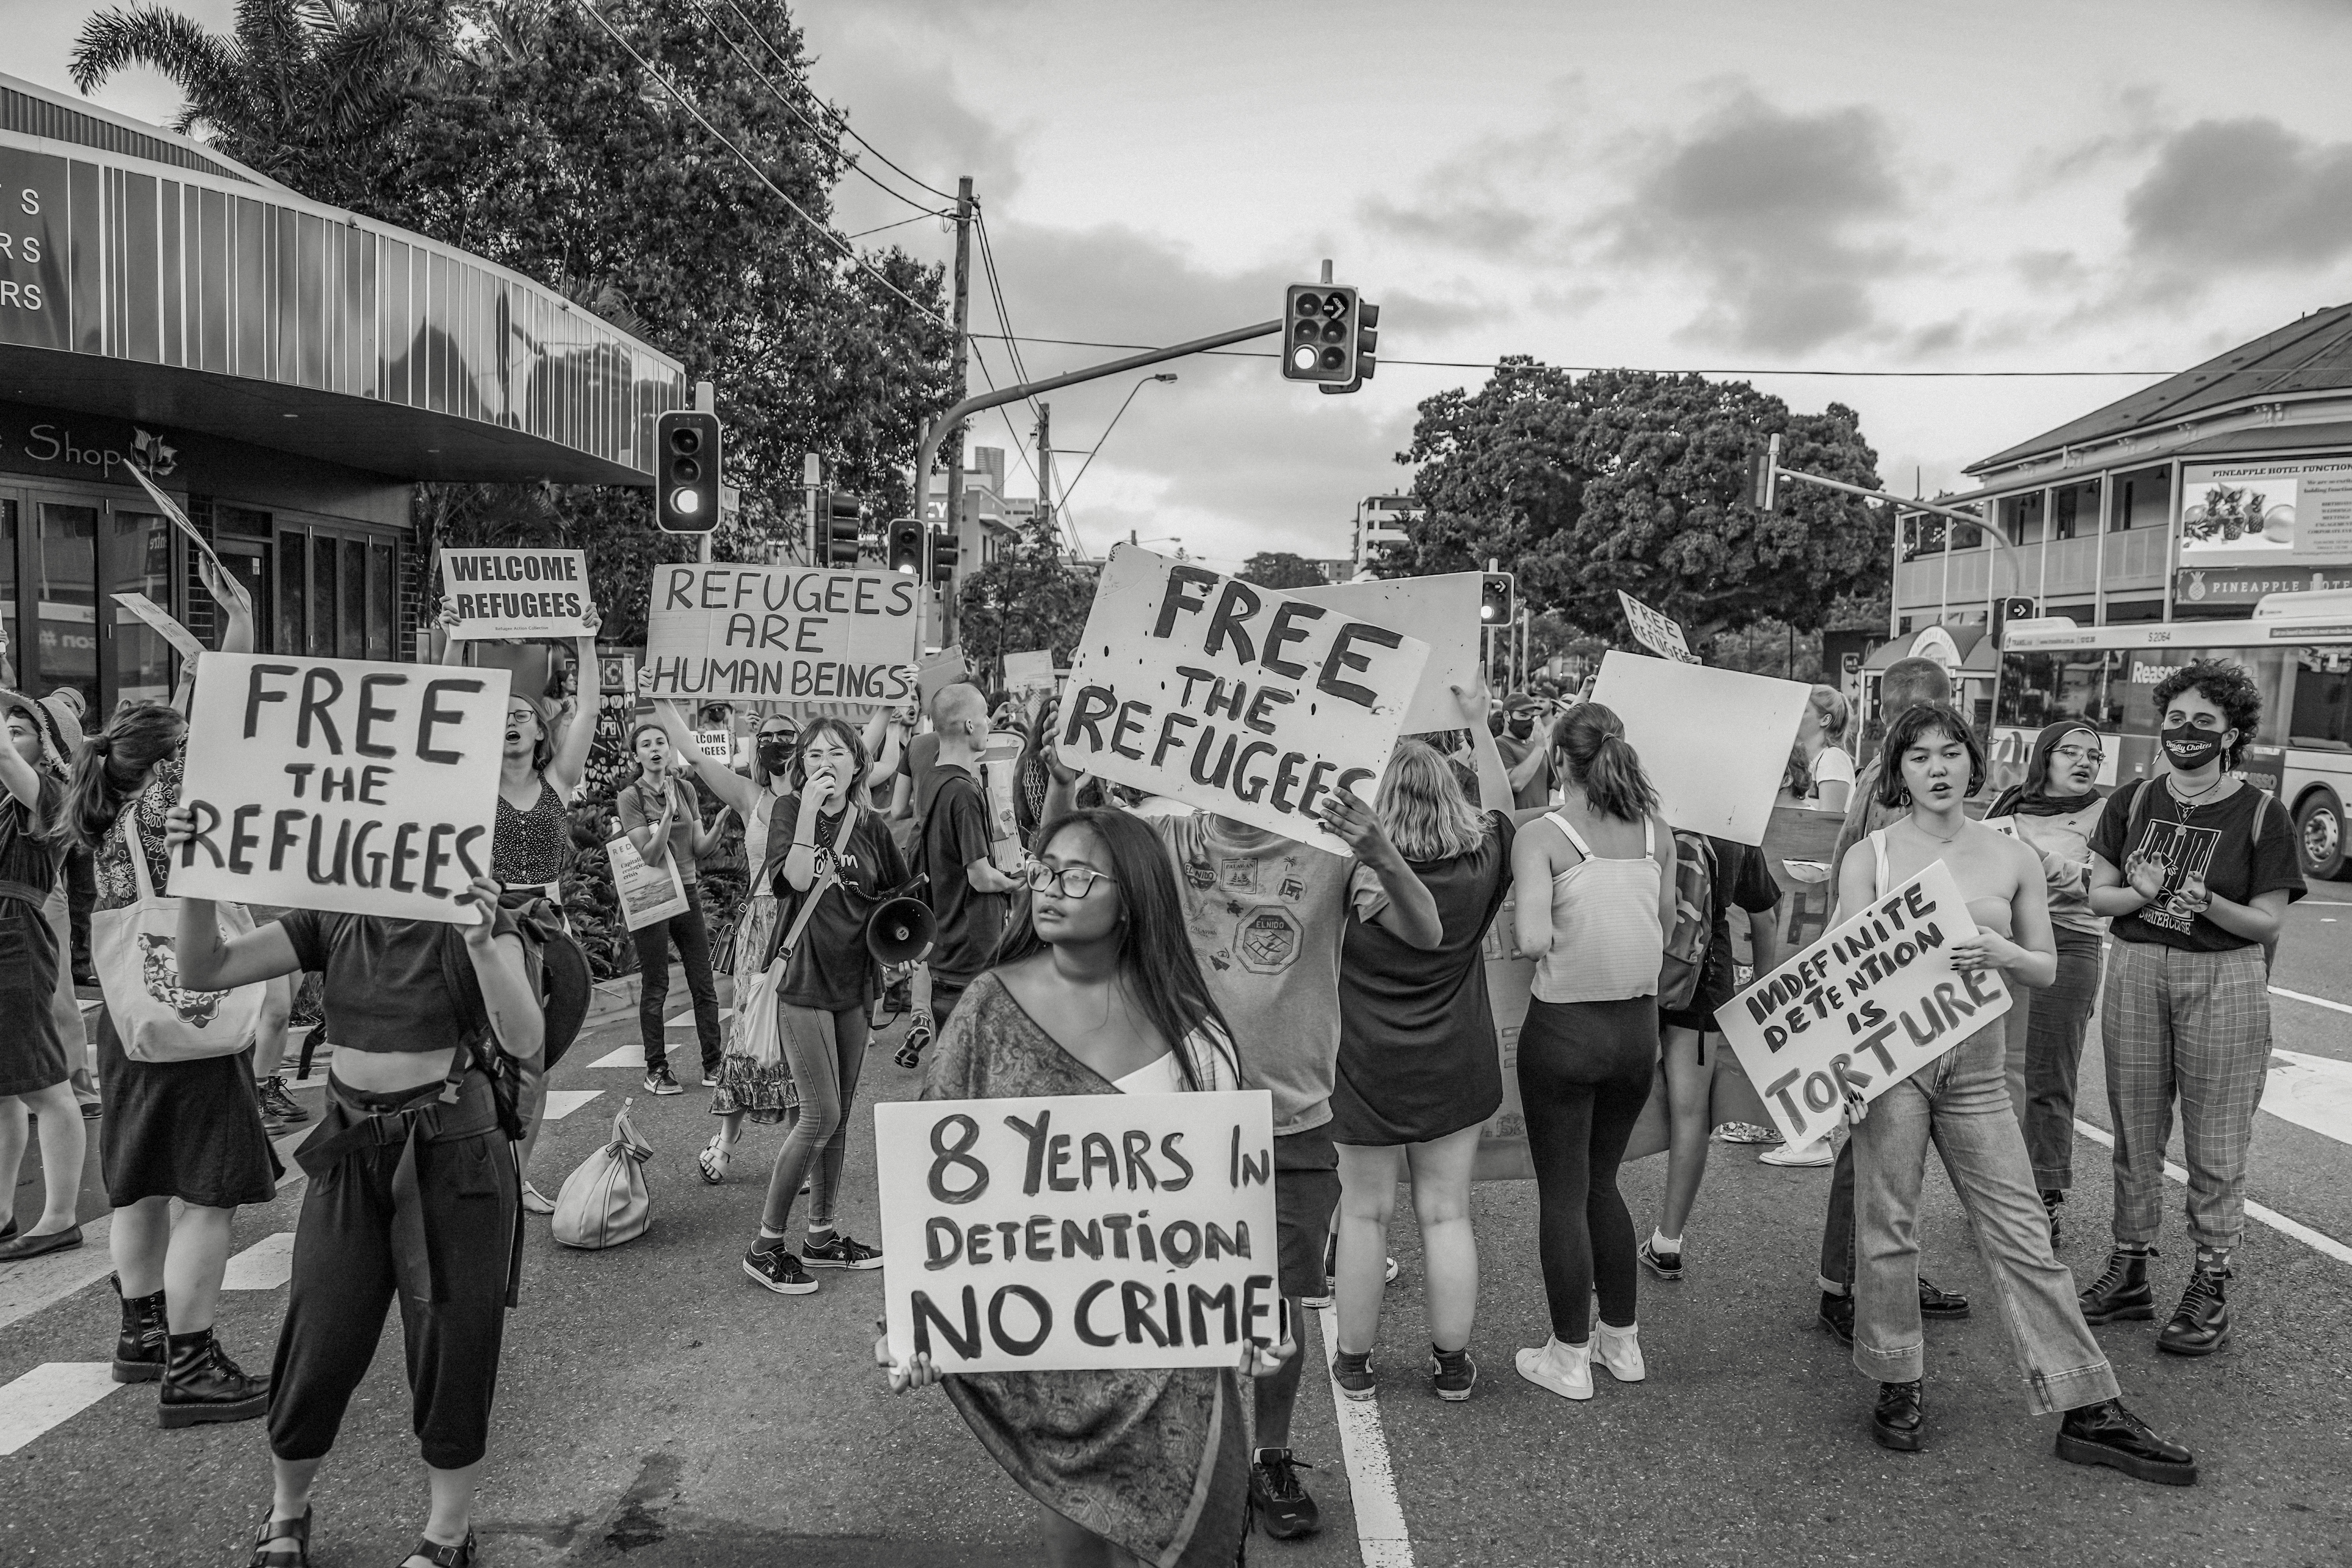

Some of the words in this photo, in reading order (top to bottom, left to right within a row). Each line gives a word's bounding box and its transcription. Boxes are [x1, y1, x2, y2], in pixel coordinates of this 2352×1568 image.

[24, 425, 121, 478] Shop
[2212, 468, 2267, 477] PINEAPPLE
[2269, 466, 2300, 474] HOTEL
[927, 501, 947, 518] CY
[450, 556, 578, 581] WELCOME
[2213, 581, 2299, 593] PINEAPPLE
[457, 593, 581, 619] REFUGEES
[666, 569, 913, 616] REFUGEES
[726, 613, 828, 653] ARE
[1153, 565, 1403, 708] FREE
[1628, 598, 1678, 639] FREE
[1646, 623, 1667, 640] THE
[652, 656, 782, 694] HUMAN
[791, 661, 908, 699] BEINGS
[244, 664, 486, 764] FREE
[1176, 666, 1295, 735] THE
[693, 734, 726, 744] LCOME
[2166, 740, 2186, 753] Deadly
[2187, 742, 2212, 751] Choices
[1063, 685, 1376, 834] REFUGEES
[284, 763, 395, 805] THE
[182, 800, 486, 906] REFUGEES
[612, 843, 632, 856] RED
[621, 857, 642, 868] Capitali
[623, 871, 638, 880] crisis
[1185, 865, 1193, 874] EL
[1196, 871, 1214, 880] NIDO
[1745, 882, 1936, 1025] INDEFINITE
[1846, 1000, 1887, 1035] IS
[1765, 971, 2002, 1136] TORTURE
[927, 1114, 989, 1204] 8
[1004, 1110, 1194, 1196] YEARS
[1230, 1124, 1270, 1191] IN
[911, 1284, 1053, 1361] NO
[1074, 1271, 1274, 1350] CRIME
